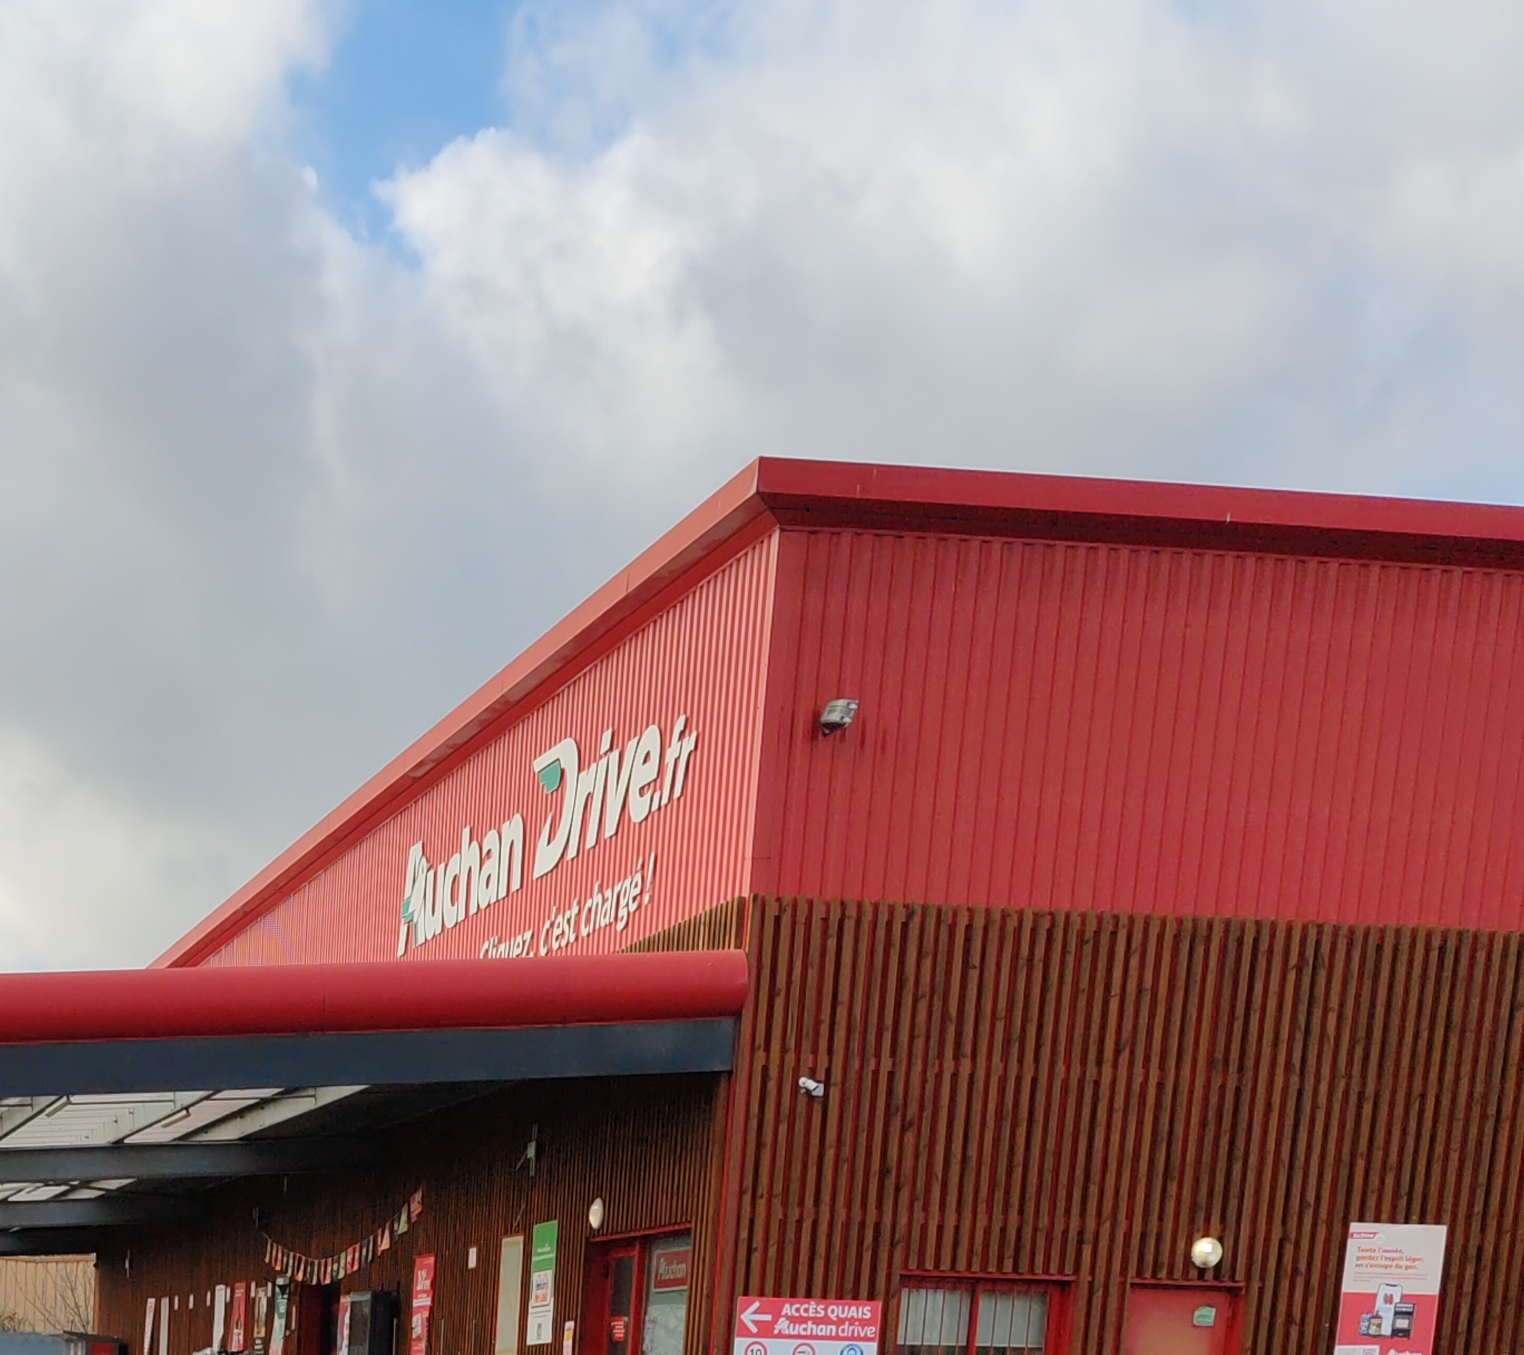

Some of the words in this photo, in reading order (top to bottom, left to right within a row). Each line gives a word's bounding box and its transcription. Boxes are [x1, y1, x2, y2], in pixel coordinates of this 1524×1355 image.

[397, 813, 524, 957] Auchan
[533, 714, 697, 880] Drive.fr
[540, 898, 580, 957] c'est
[774, 1317, 837, 1337] Auchan
[838, 1321, 876, 1337] drive
[781, 1301, 825, 1318] ACCÈS
[827, 1305, 872, 1320] QUAIS
